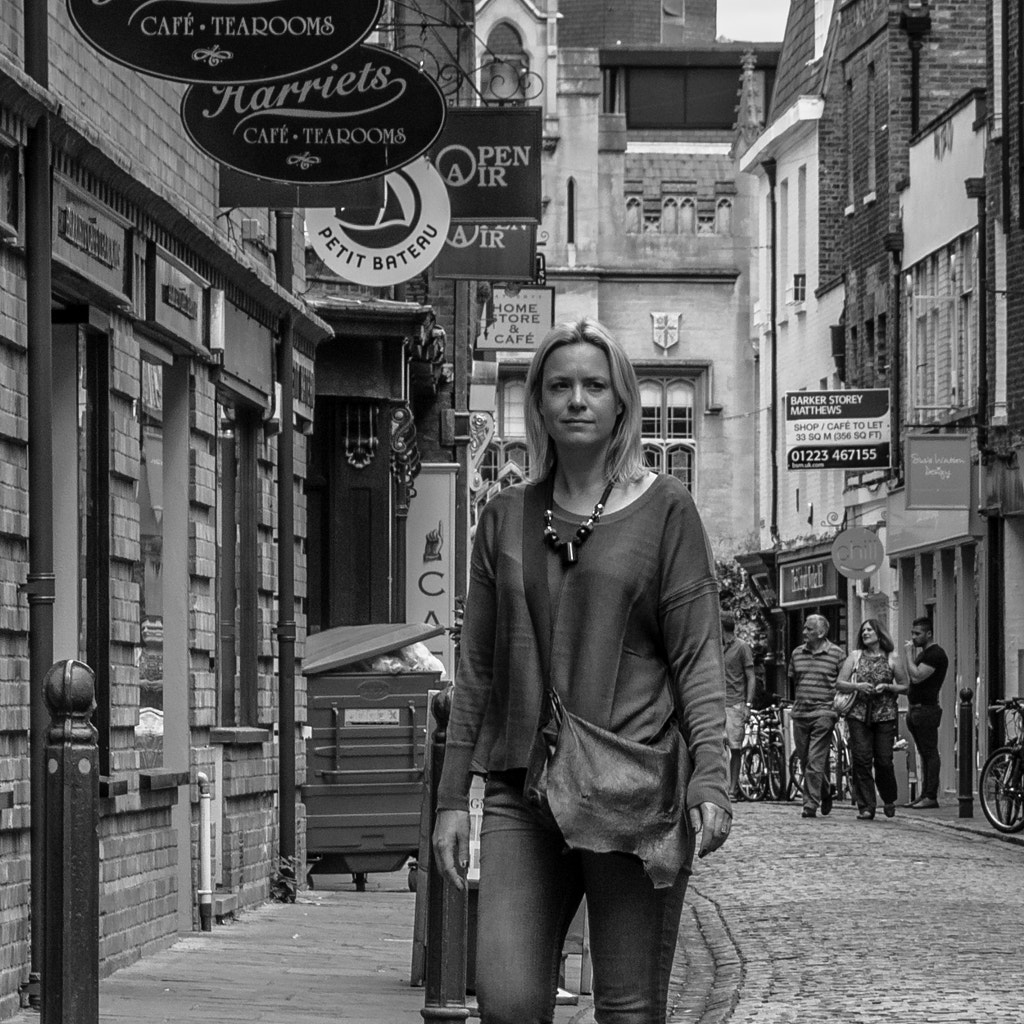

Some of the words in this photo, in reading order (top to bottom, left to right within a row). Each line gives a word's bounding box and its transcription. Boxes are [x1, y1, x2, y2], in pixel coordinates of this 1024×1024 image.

[141, 12, 194, 36] CAFÉ
[211, 16, 335, 36] TEAROOMS
[202, 62, 406, 119] Harriets
[243, 124, 289, 144] CAFÉ
[303, 128, 407, 144] TEAROOMS
[318, 227, 366, 268] PETIT
[373, 224, 438, 270] BATEAU
[493, 303, 538, 313] HOME
[492, 313, 541, 324] STORE
[509, 324, 519, 334] &
[494, 332, 534, 344] CAFÉ
[790, 396, 827, 406] BARKER
[829, 395, 863, 405] STOREY
[790, 405, 842, 415] MATTHEWS
[794, 423, 819, 431] SHOP
[826, 420, 851, 430] CAFÉ
[853, 421, 865, 429] TO
[796, 433, 806, 441] 33
[808, 432, 821, 440] SQ
[823, 432, 832, 440] M
[833, 431, 851, 441] (356
[853, 431, 866, 440] SQ
[868, 430, 882, 439] FT)
[791, 450, 829, 462] 01223
[831, 448, 877, 461] 467155
